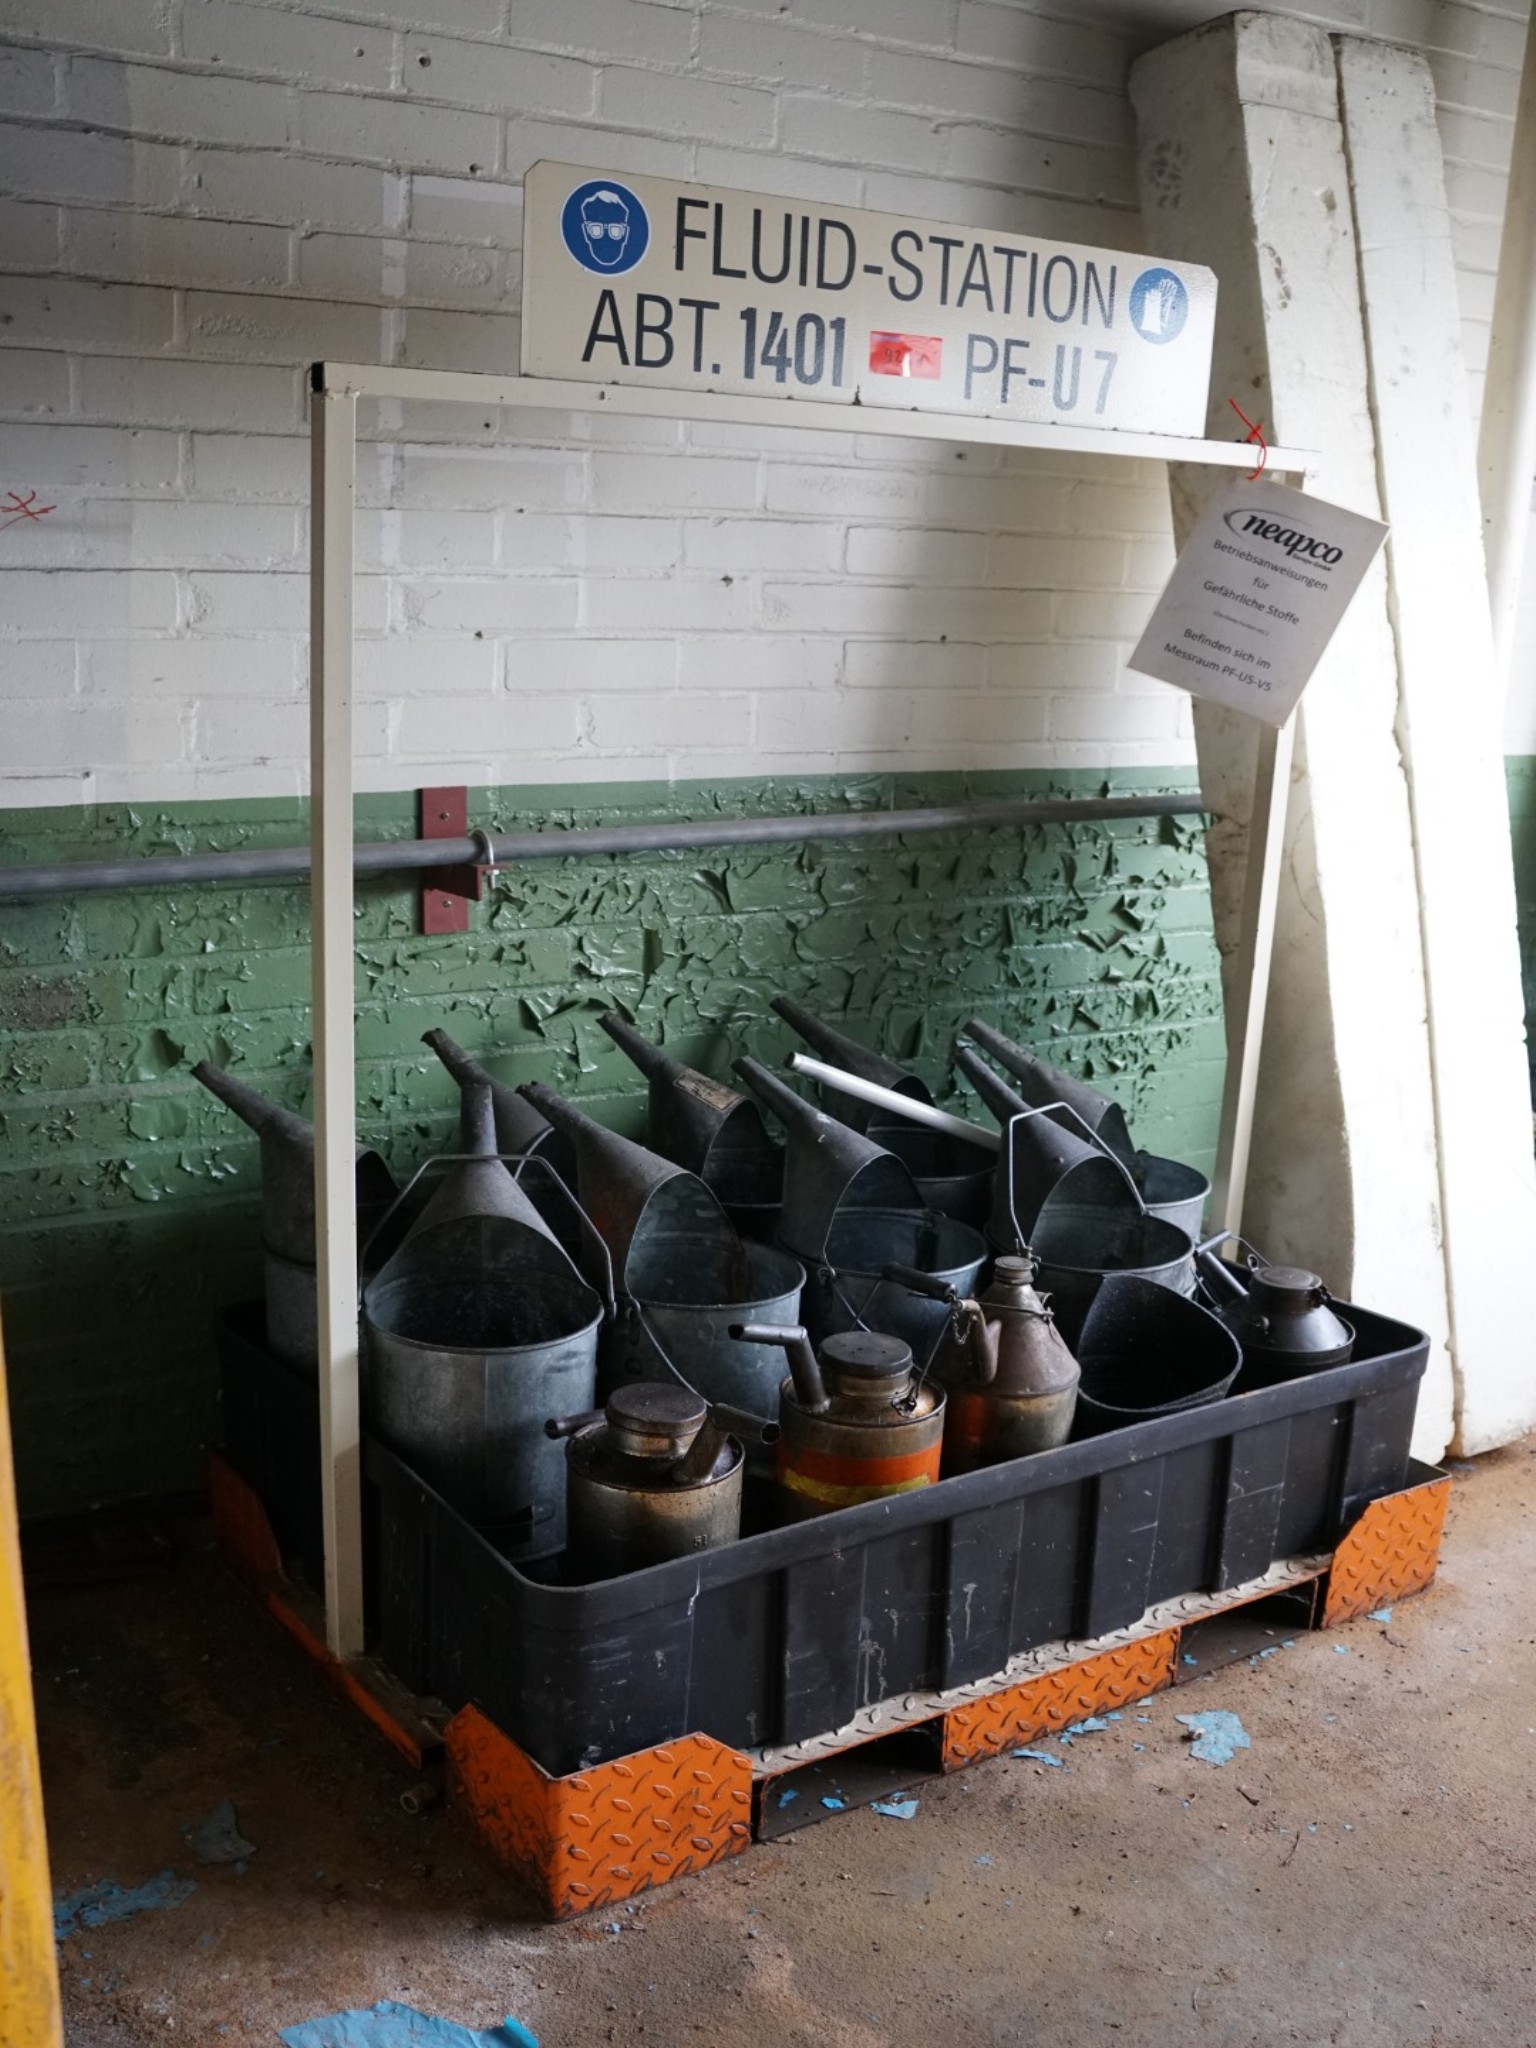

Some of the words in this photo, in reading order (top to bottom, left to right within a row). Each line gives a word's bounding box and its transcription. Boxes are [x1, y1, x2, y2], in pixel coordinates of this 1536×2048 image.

[674, 196, 1116, 330] FLUID-STATION
[582, 289, 720, 375] ABT.
[739, 307, 846, 387] 1401
[1241, 515, 1343, 564] neapco
[1213, 539, 1328, 591] Betriebsanweisungen
[1253, 577, 1270, 590] für
[1203, 580, 1265, 611] Gefährliche
[1266, 605, 1300, 625] Stoffe
[1164, 643, 1221, 671] Messraum
[1184, 628, 1232, 655] Befinden
[1235, 649, 1254, 664] sich
[1257, 656, 1271, 669] im
